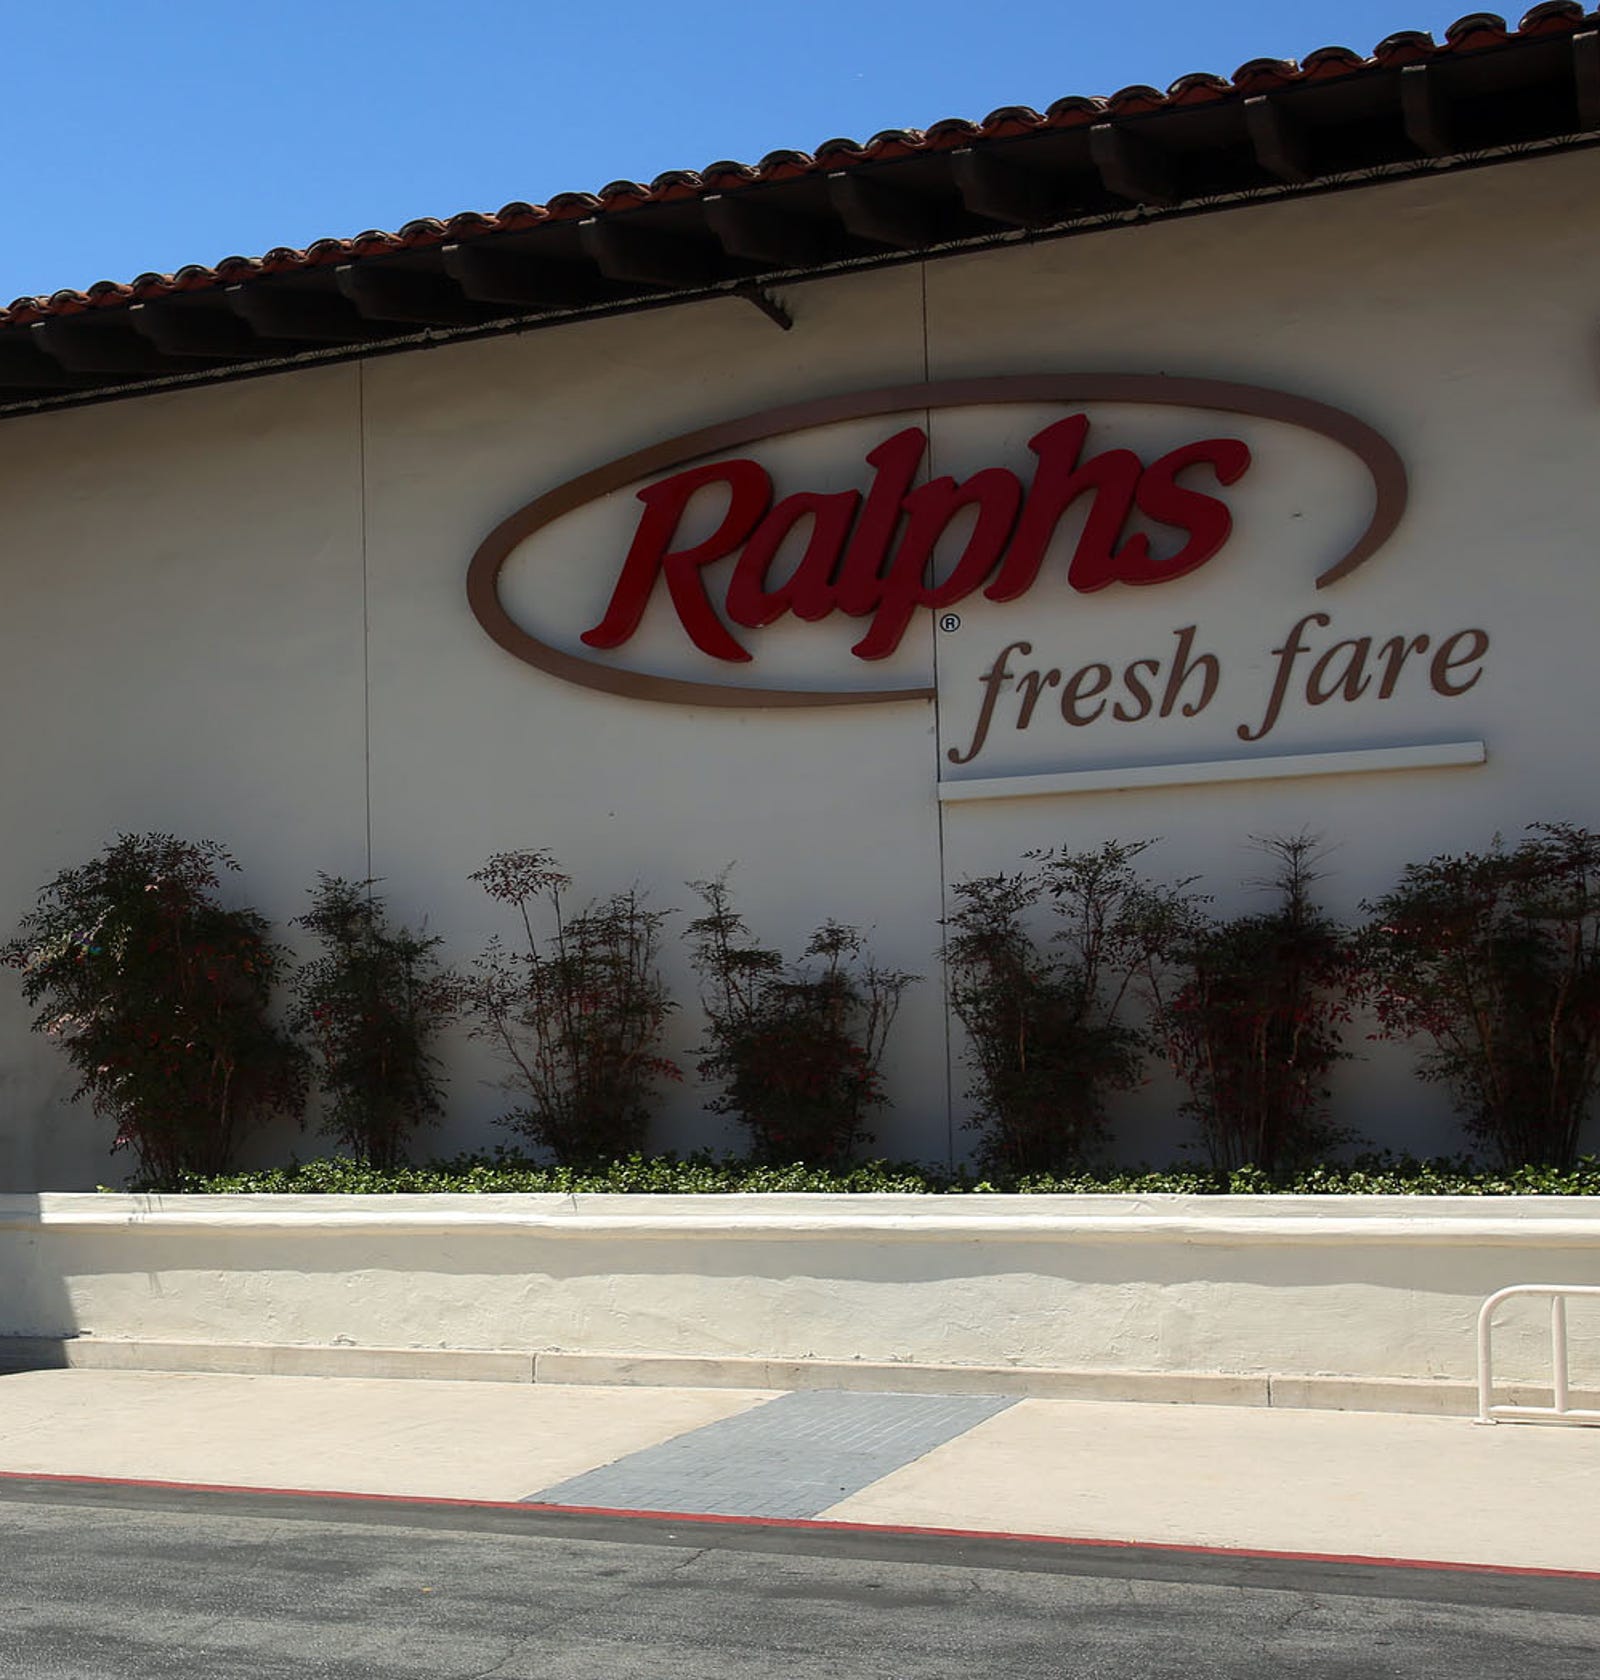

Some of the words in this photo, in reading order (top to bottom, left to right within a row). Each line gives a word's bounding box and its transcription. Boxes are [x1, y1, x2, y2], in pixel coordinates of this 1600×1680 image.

[580, 413, 1251, 663] Ralphs
[947, 626, 1220, 764] fresh
[1237, 612, 1490, 742] fare
